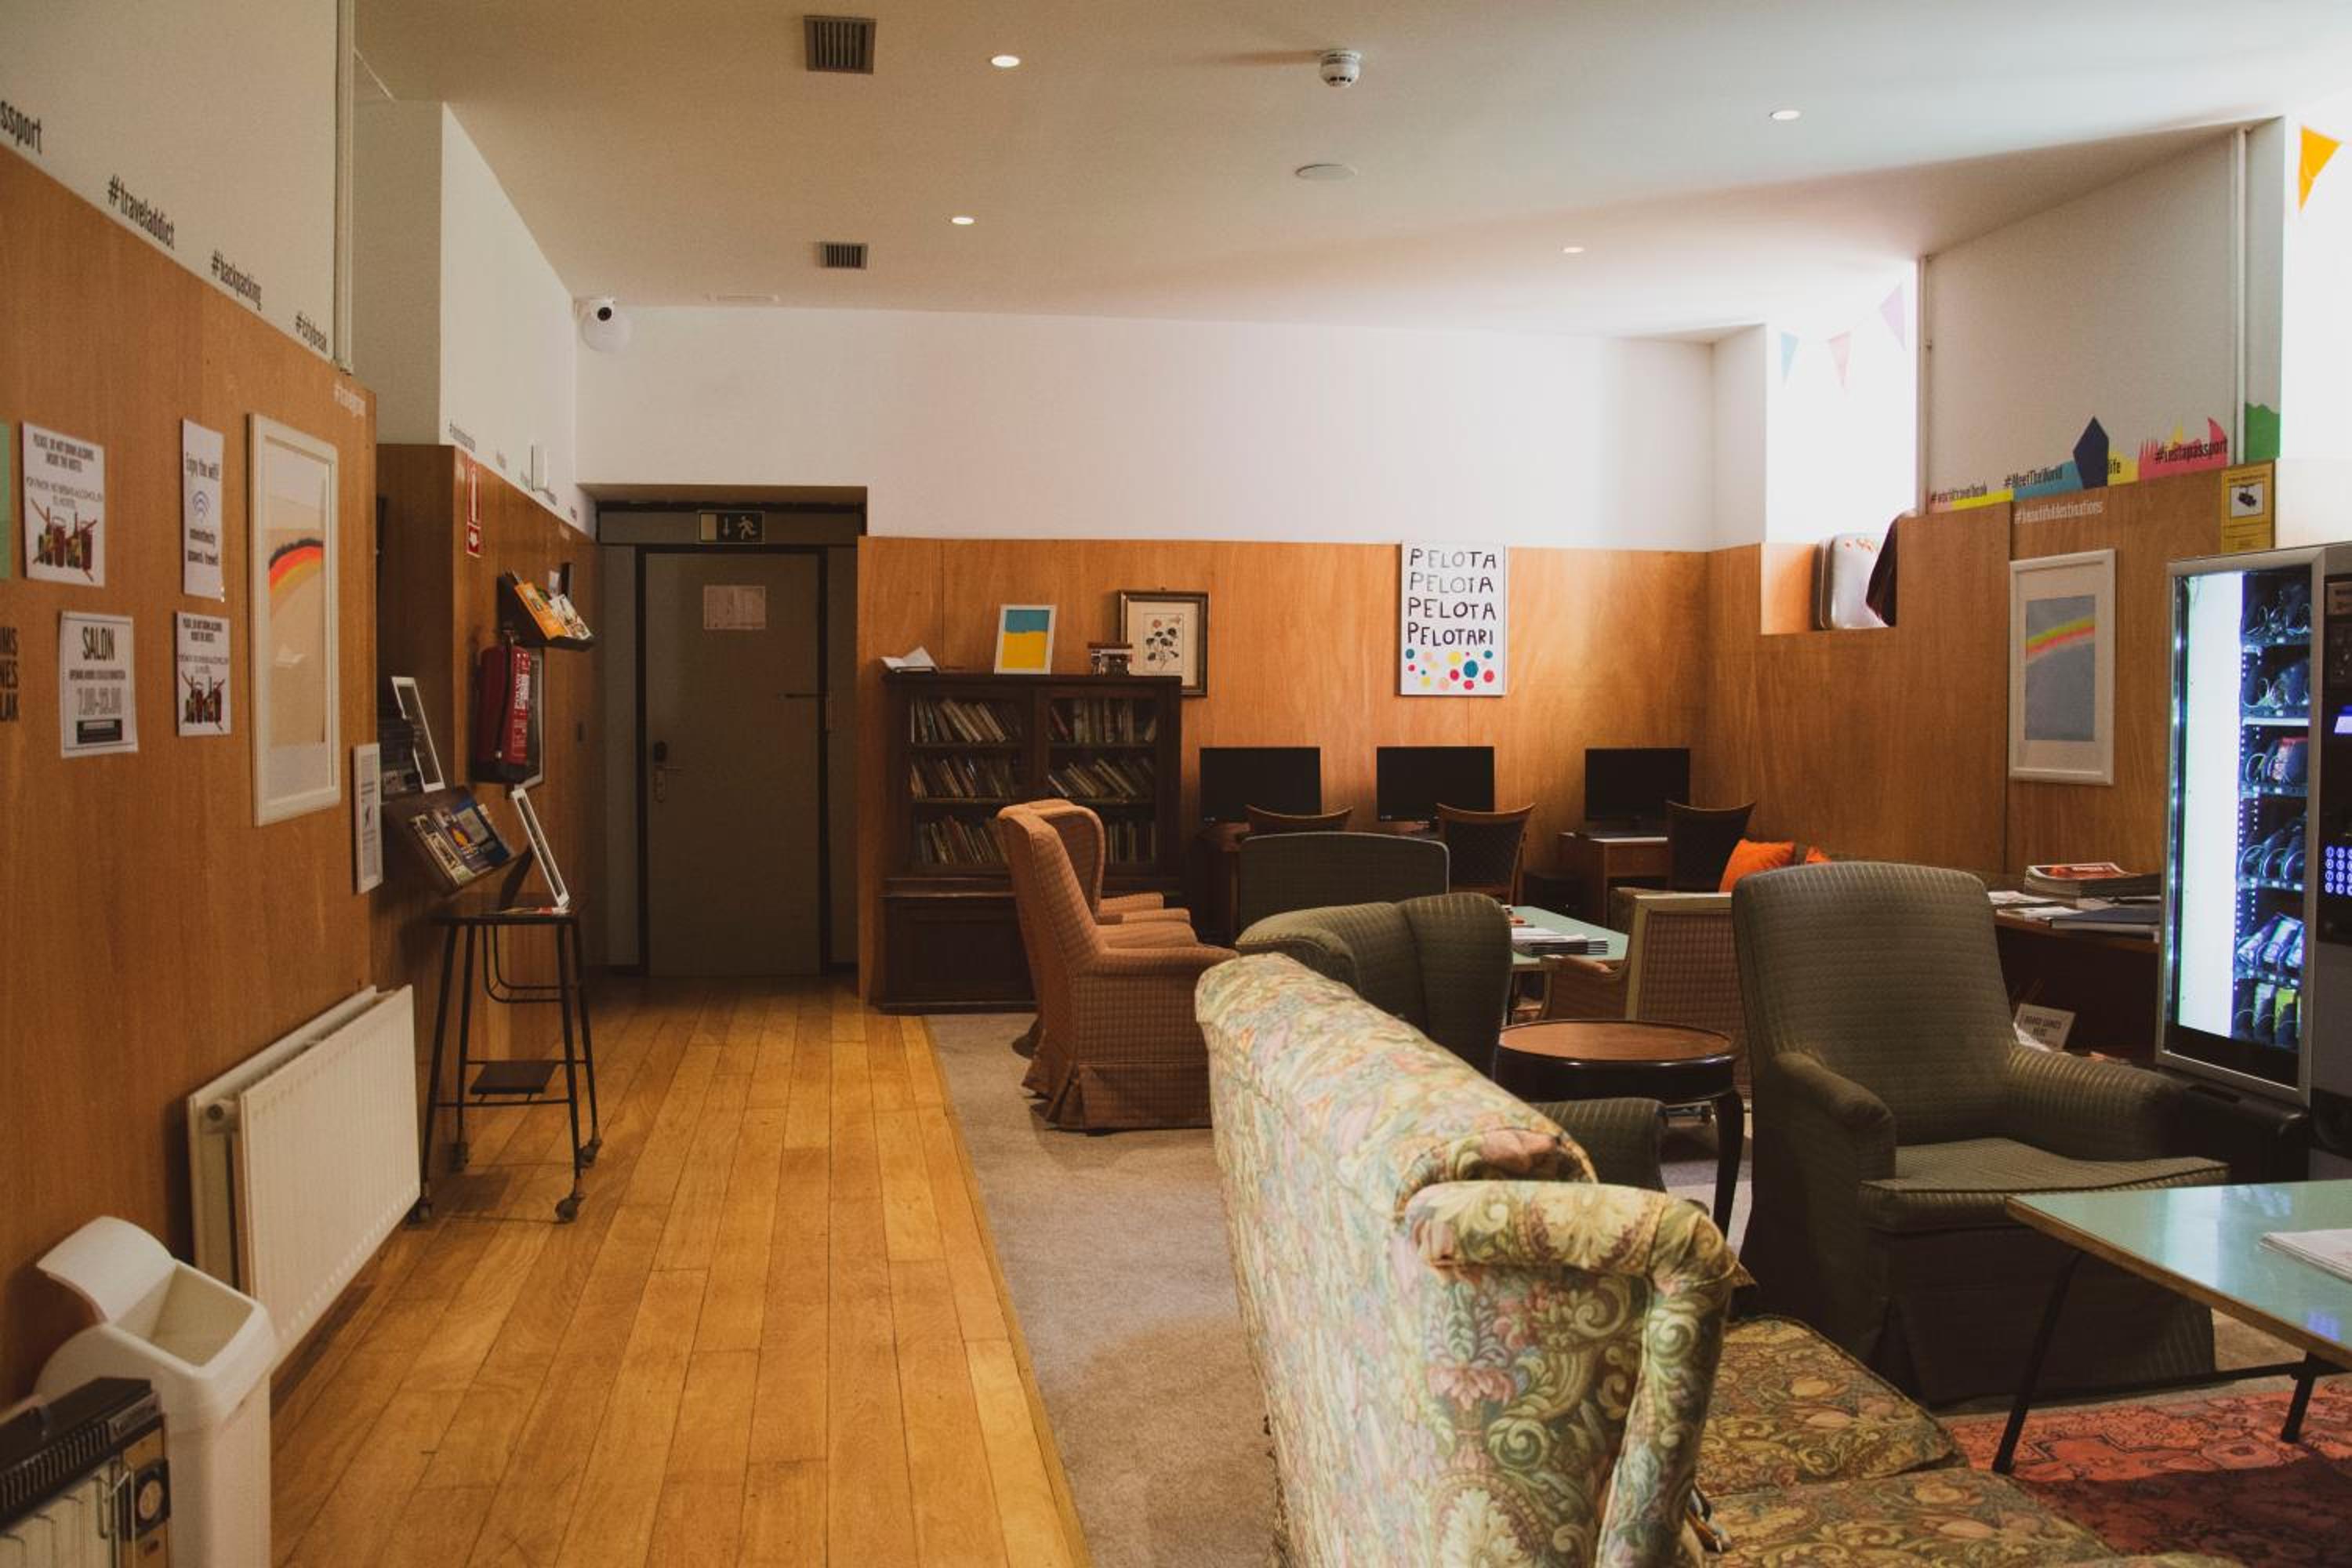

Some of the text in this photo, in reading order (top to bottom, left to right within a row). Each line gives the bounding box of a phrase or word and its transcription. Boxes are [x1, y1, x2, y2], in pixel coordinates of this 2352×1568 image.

[107, 173, 175, 251] #traveladdict
[2155, 436, 2228, 465] #instapassport
[1409, 548, 1497, 568] PELOTA
[1409, 572, 1494, 593] PELOTA
[1408, 597, 1497, 620] PELOTA
[82, 626, 115, 661] SALON
[1407, 622, 1494, 647] PELOTARI
